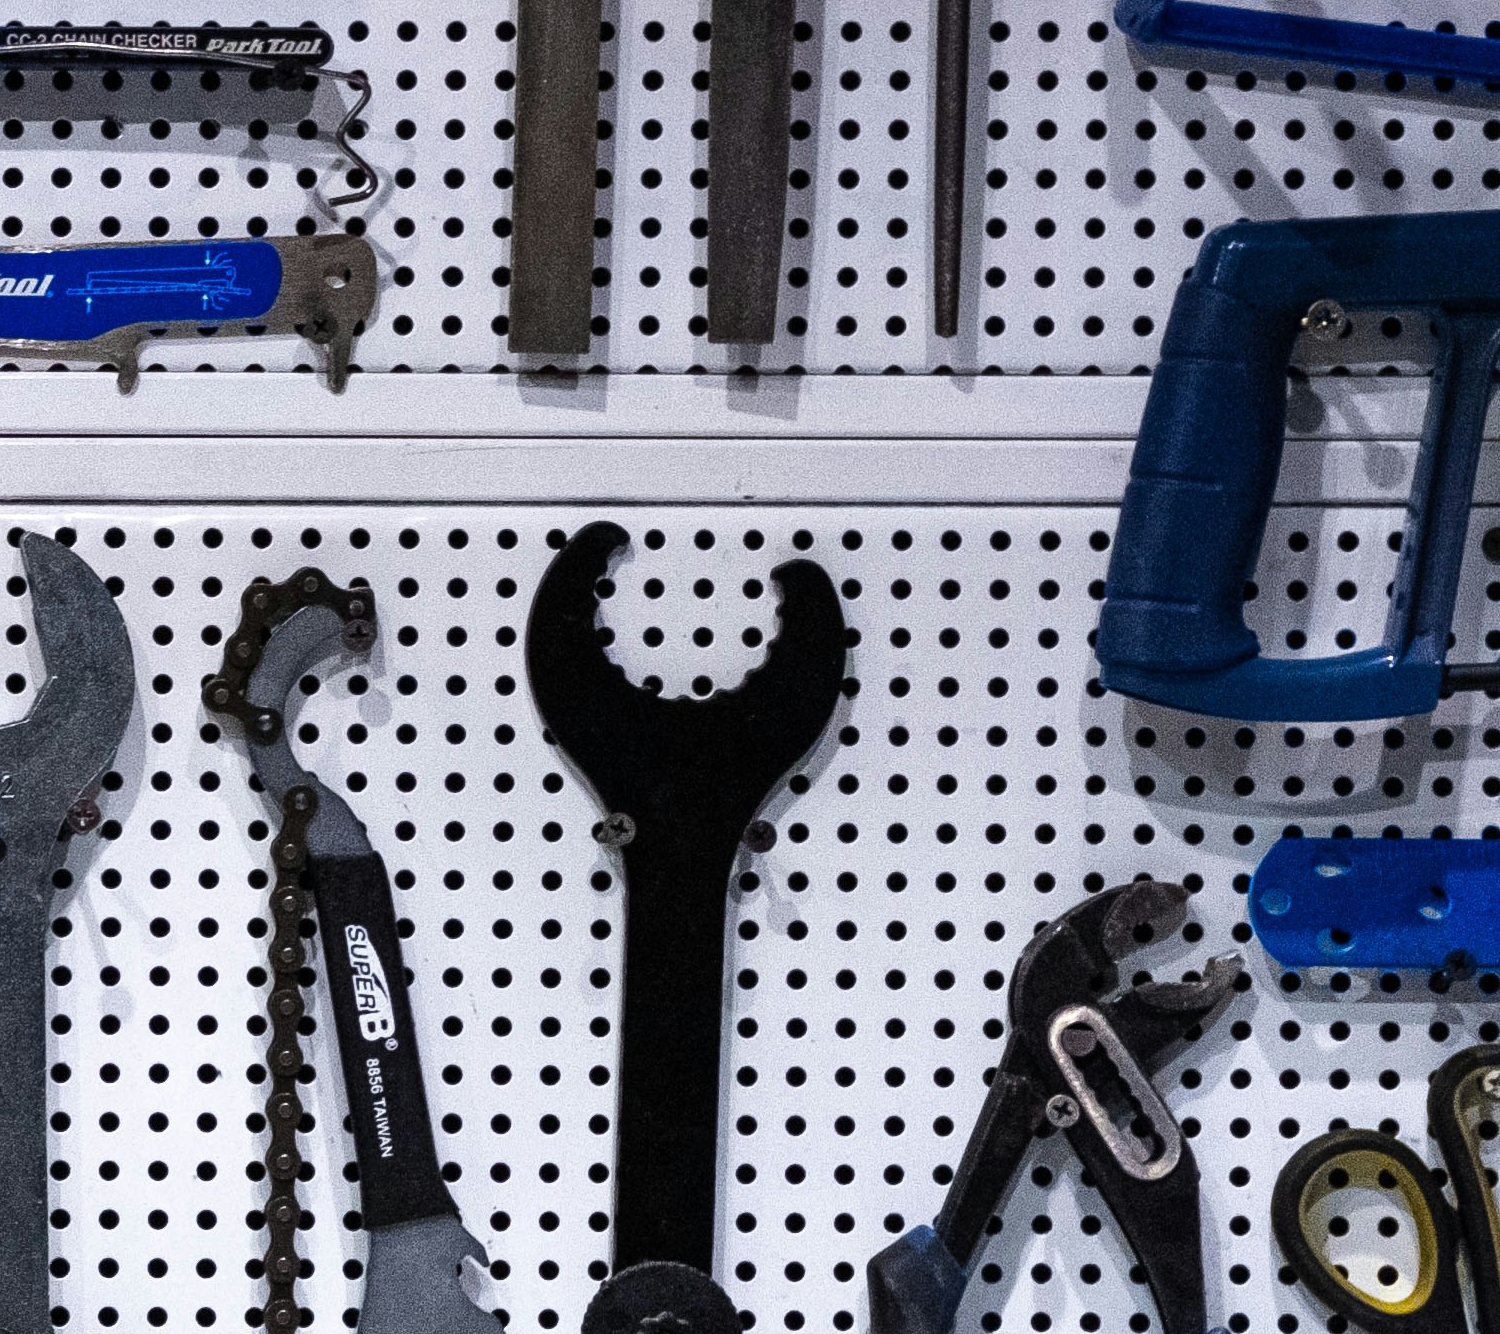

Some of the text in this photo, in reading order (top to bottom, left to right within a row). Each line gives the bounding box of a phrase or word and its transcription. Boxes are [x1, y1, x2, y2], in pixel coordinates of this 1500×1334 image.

[110, 34, 198, 49] CHECKER
[365, 1057, 395, 1159] 8856 TAIWAN
